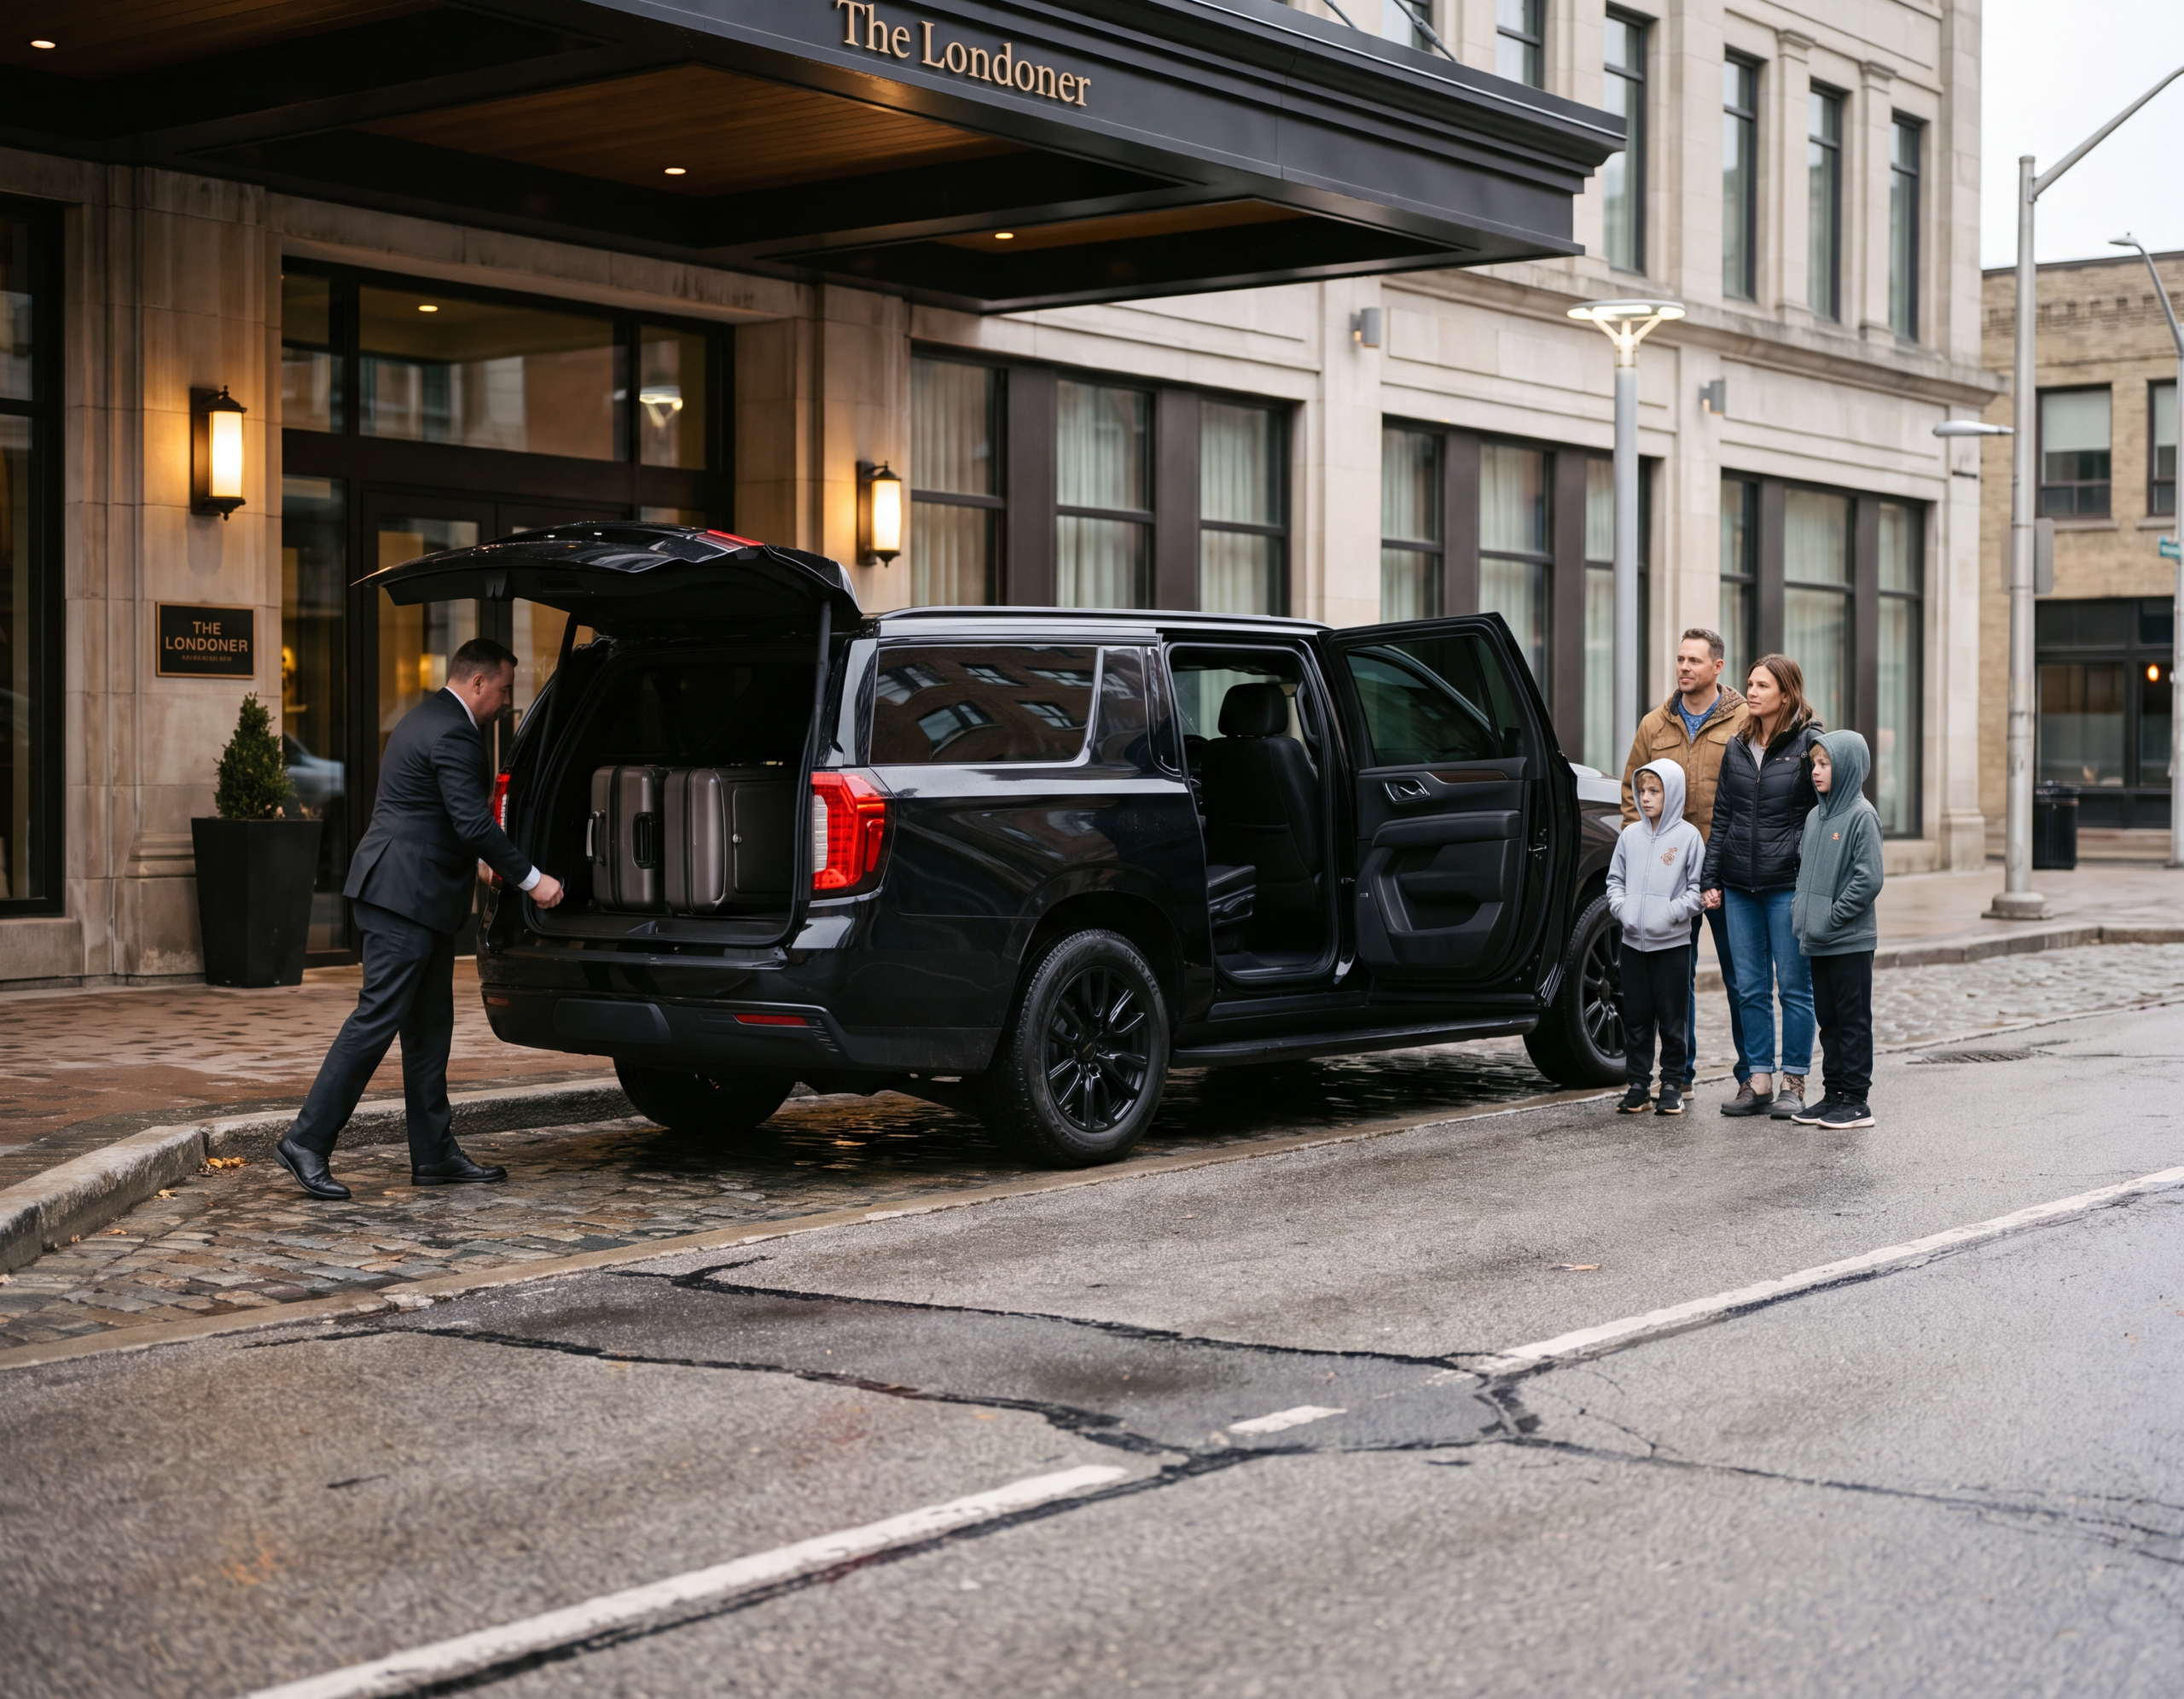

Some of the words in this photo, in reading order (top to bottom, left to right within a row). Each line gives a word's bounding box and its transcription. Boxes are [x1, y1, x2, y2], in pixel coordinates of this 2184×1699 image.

[836, 0, 911, 59] The
[920, 20, 1092, 107] Londoner
[192, 620, 222, 636] THE
[165, 636, 249, 653] LONDONER
